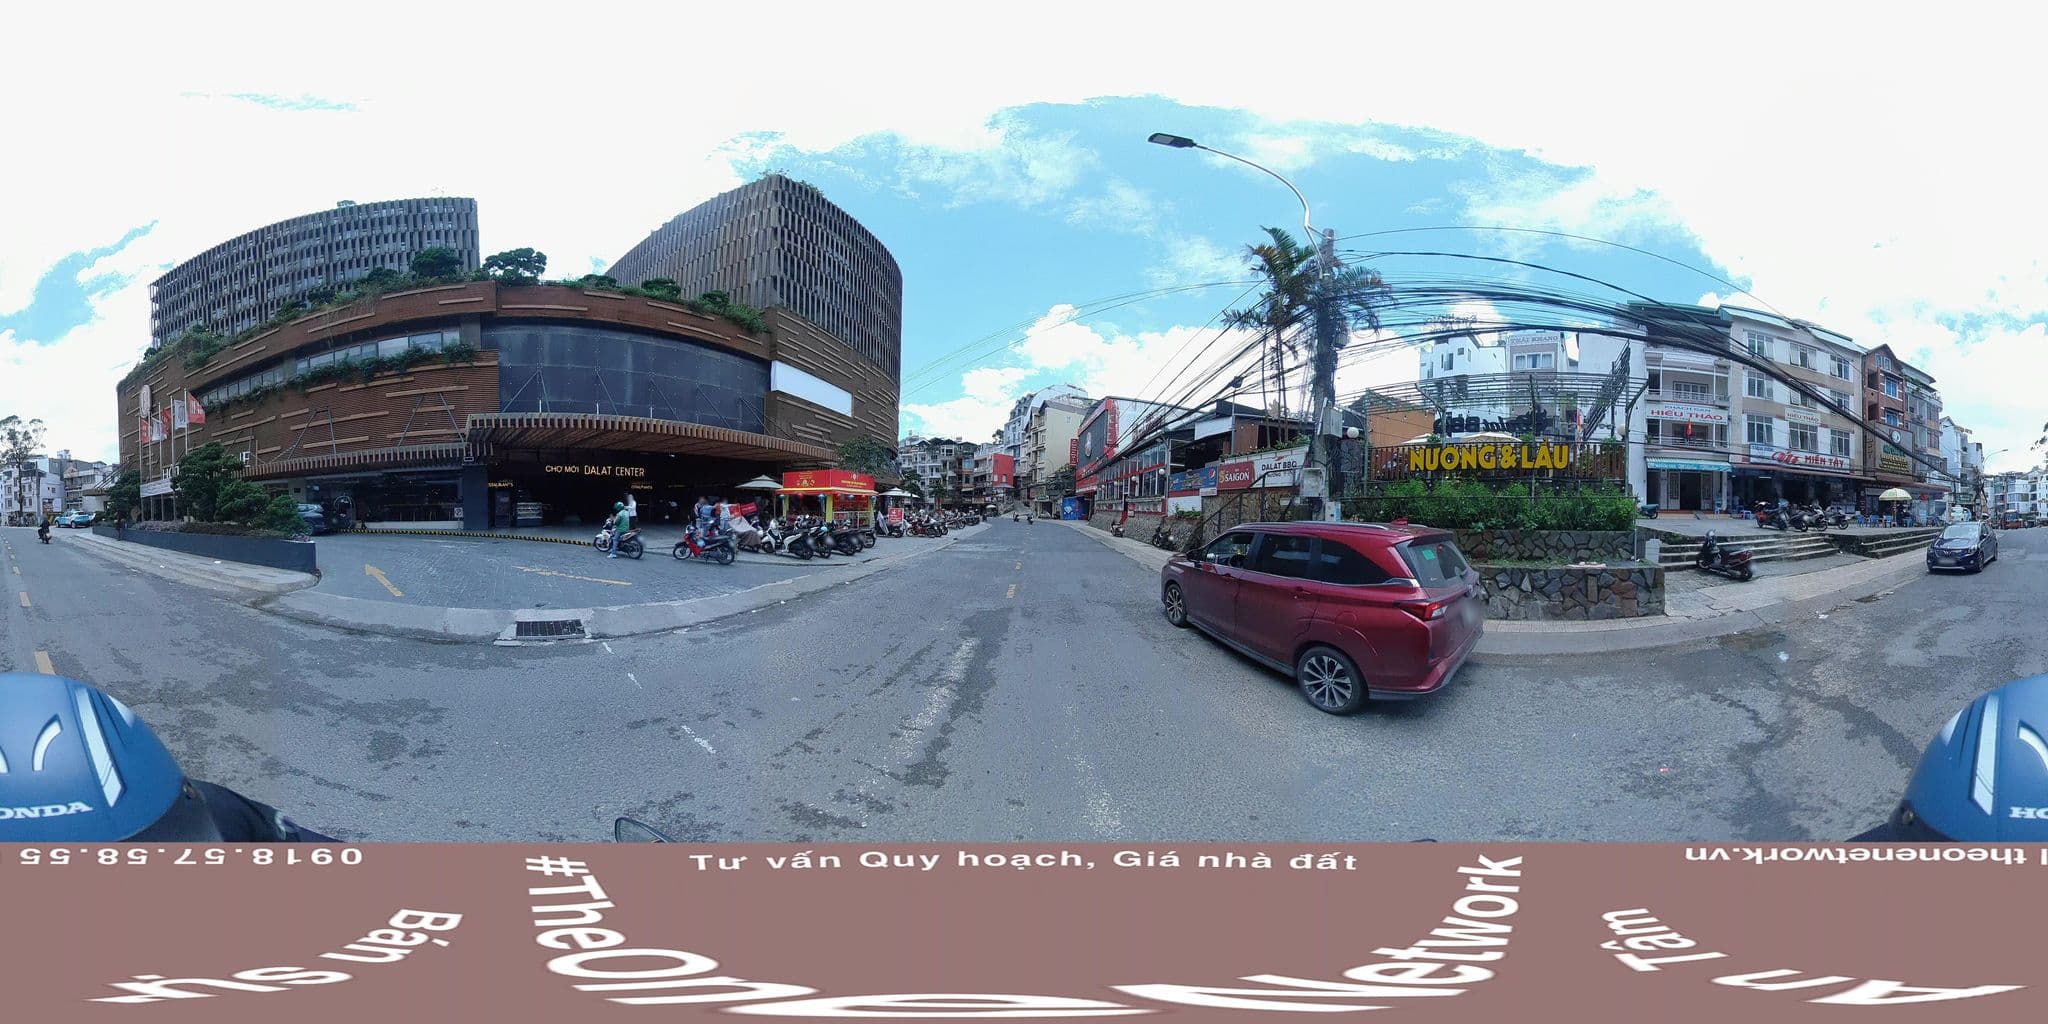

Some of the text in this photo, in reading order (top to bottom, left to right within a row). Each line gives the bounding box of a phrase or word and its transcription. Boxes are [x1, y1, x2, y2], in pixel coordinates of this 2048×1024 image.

[1500, 445, 1517, 470] &
[584, 465, 612, 476] DALAT
[615, 466, 645, 477] CENTER
[1261, 460, 1298, 471] DALAT BBQ
[1225, 471, 1250, 482] SAIGON
